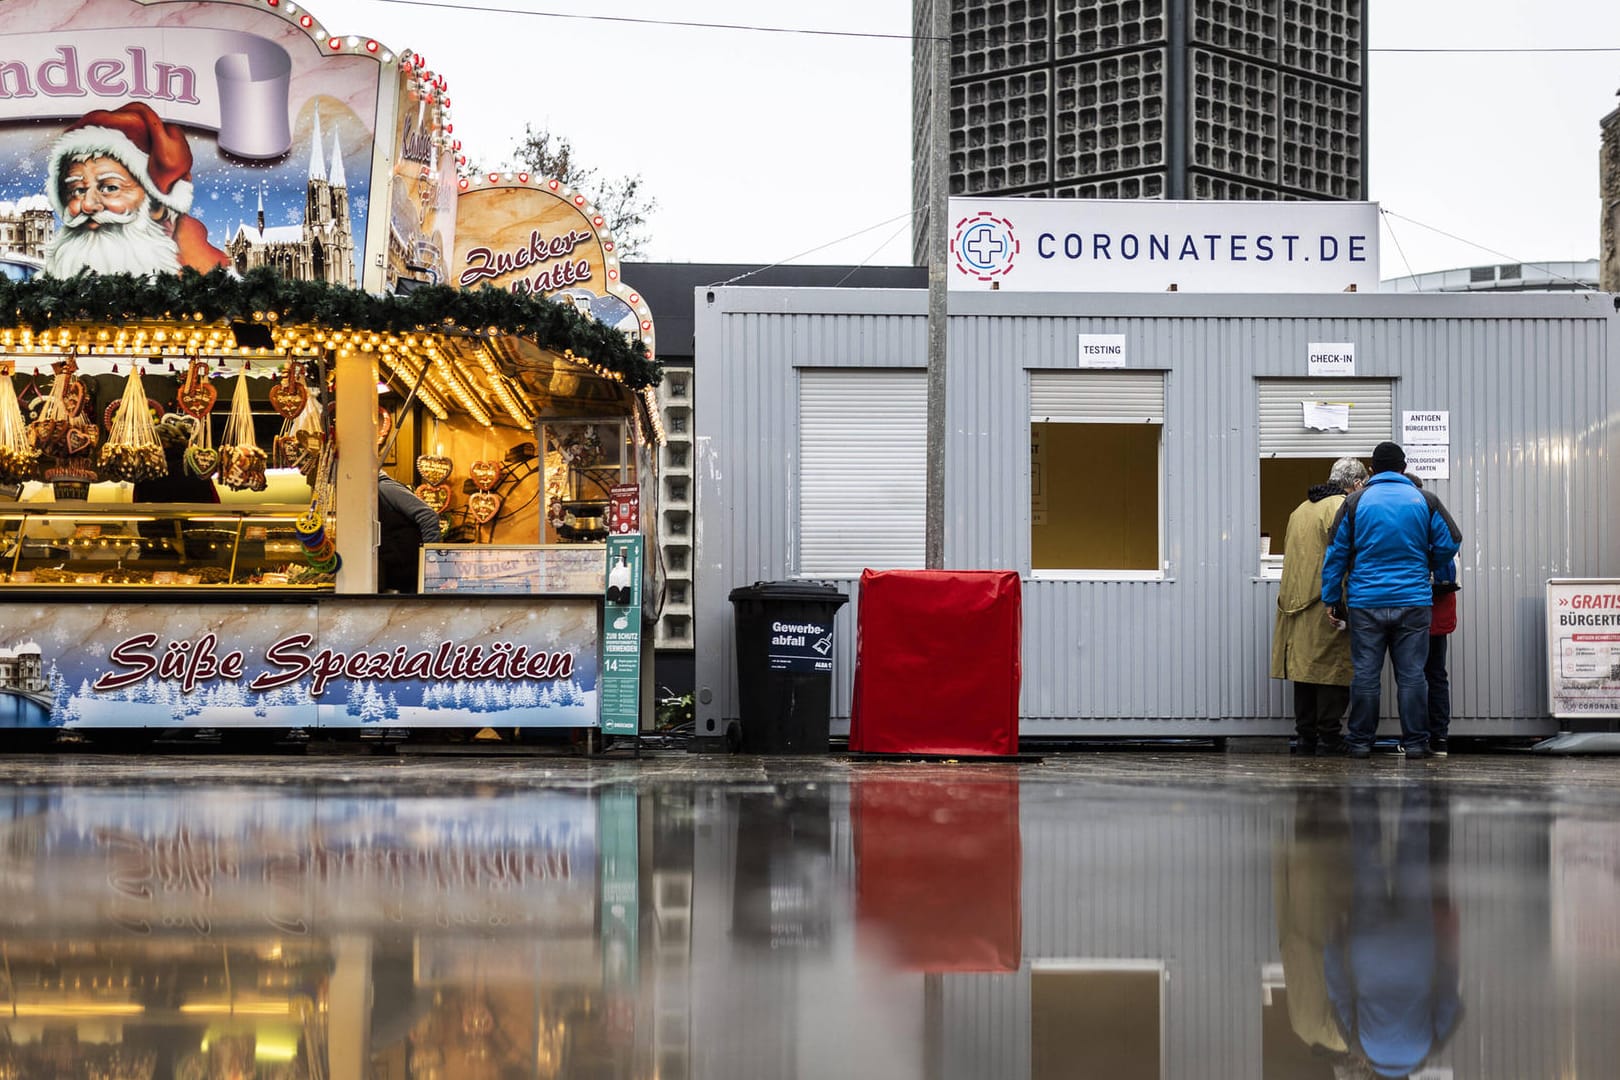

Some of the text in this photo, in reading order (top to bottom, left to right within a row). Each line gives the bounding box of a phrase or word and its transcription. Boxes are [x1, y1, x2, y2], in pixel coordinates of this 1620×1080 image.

[1037, 232, 1368, 263] CORONATEST.DE
[460, 230, 592, 285] Zucker-
[1083, 344, 1121, 355] TESTING
[1310, 353, 1353, 363] CHECK-IN
[772, 622, 824, 634] Gewerbe-
[772, 635, 805, 646] abfall
[94, 632, 243, 694] Süße
[250, 632, 575, 699] Spezialitäten
[604, 658, 618, 672] 14
